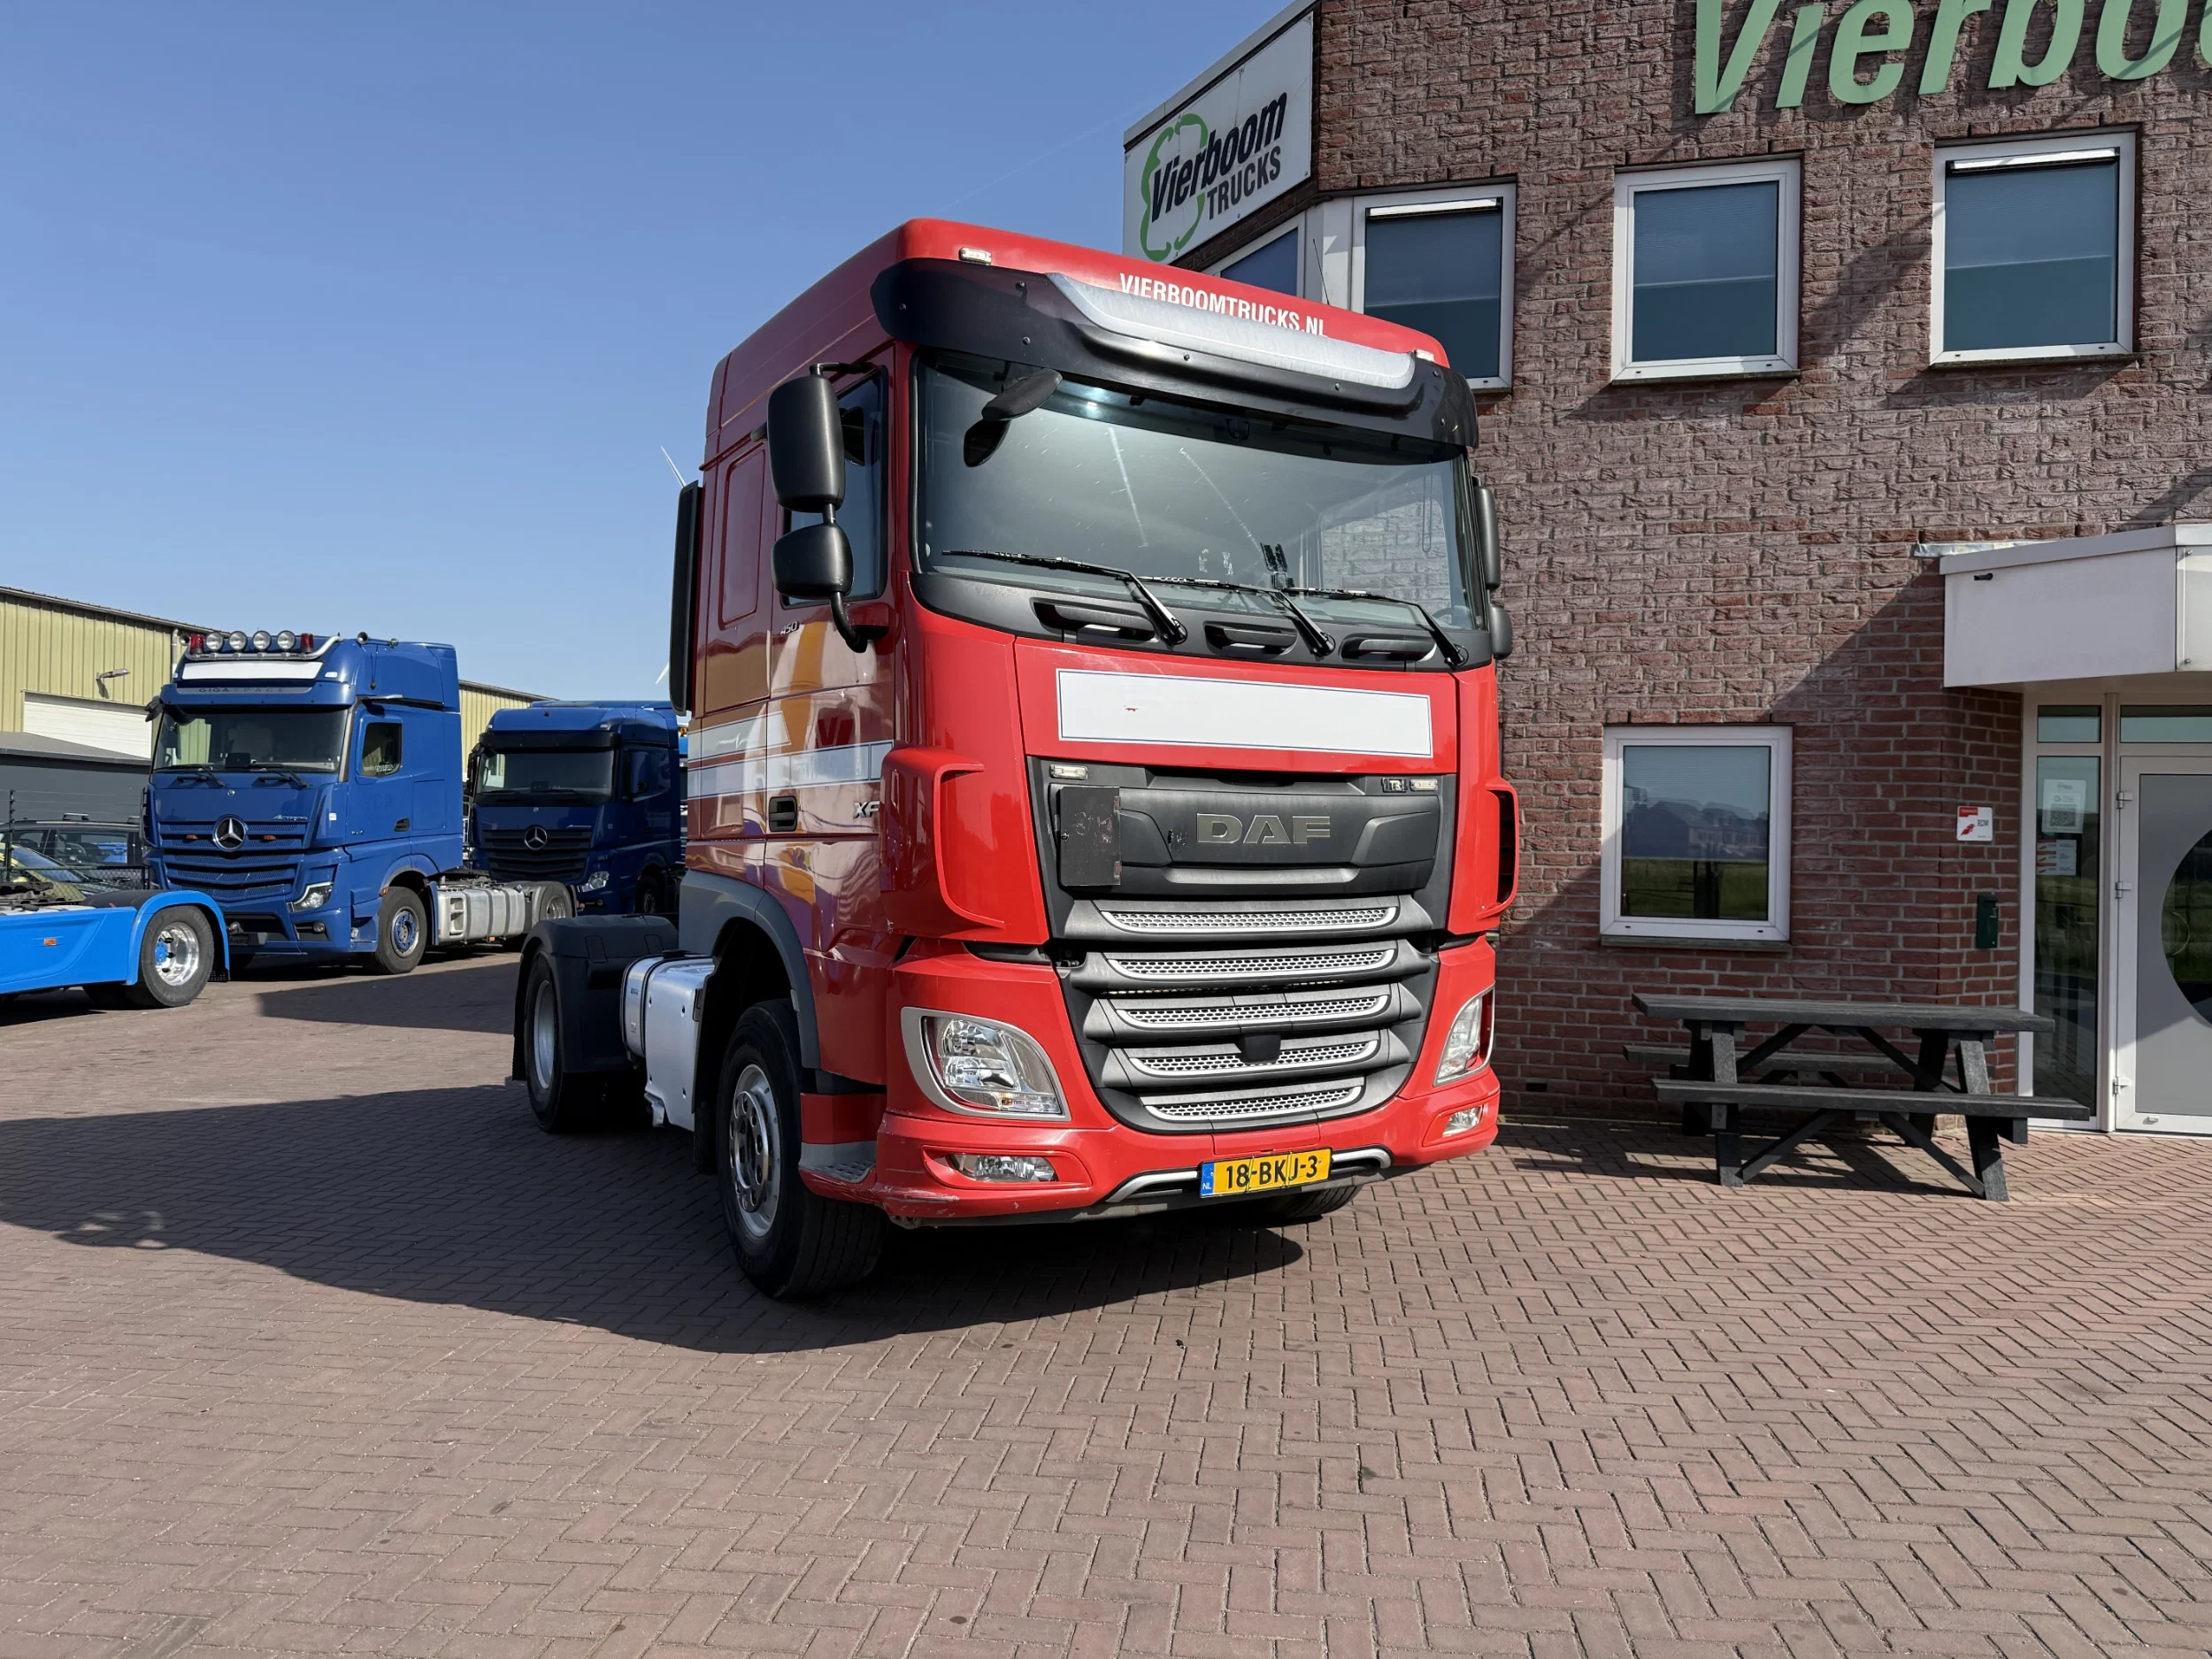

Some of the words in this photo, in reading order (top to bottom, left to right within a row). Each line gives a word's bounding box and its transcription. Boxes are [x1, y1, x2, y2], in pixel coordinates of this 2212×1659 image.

[1695, 0, 2212, 114] Vierbo
[1152, 92, 1287, 222] Vierboom
[1207, 145, 1281, 220] TRUCKS
[1119, 273, 1325, 337] VIERBOOMTRUCKS.NL
[780, 621, 798, 634] 450
[853, 801, 880, 818] XF
[1197, 813, 1331, 844] DAF
[1226, 1156, 1318, 1188] 18-BKJ-3
